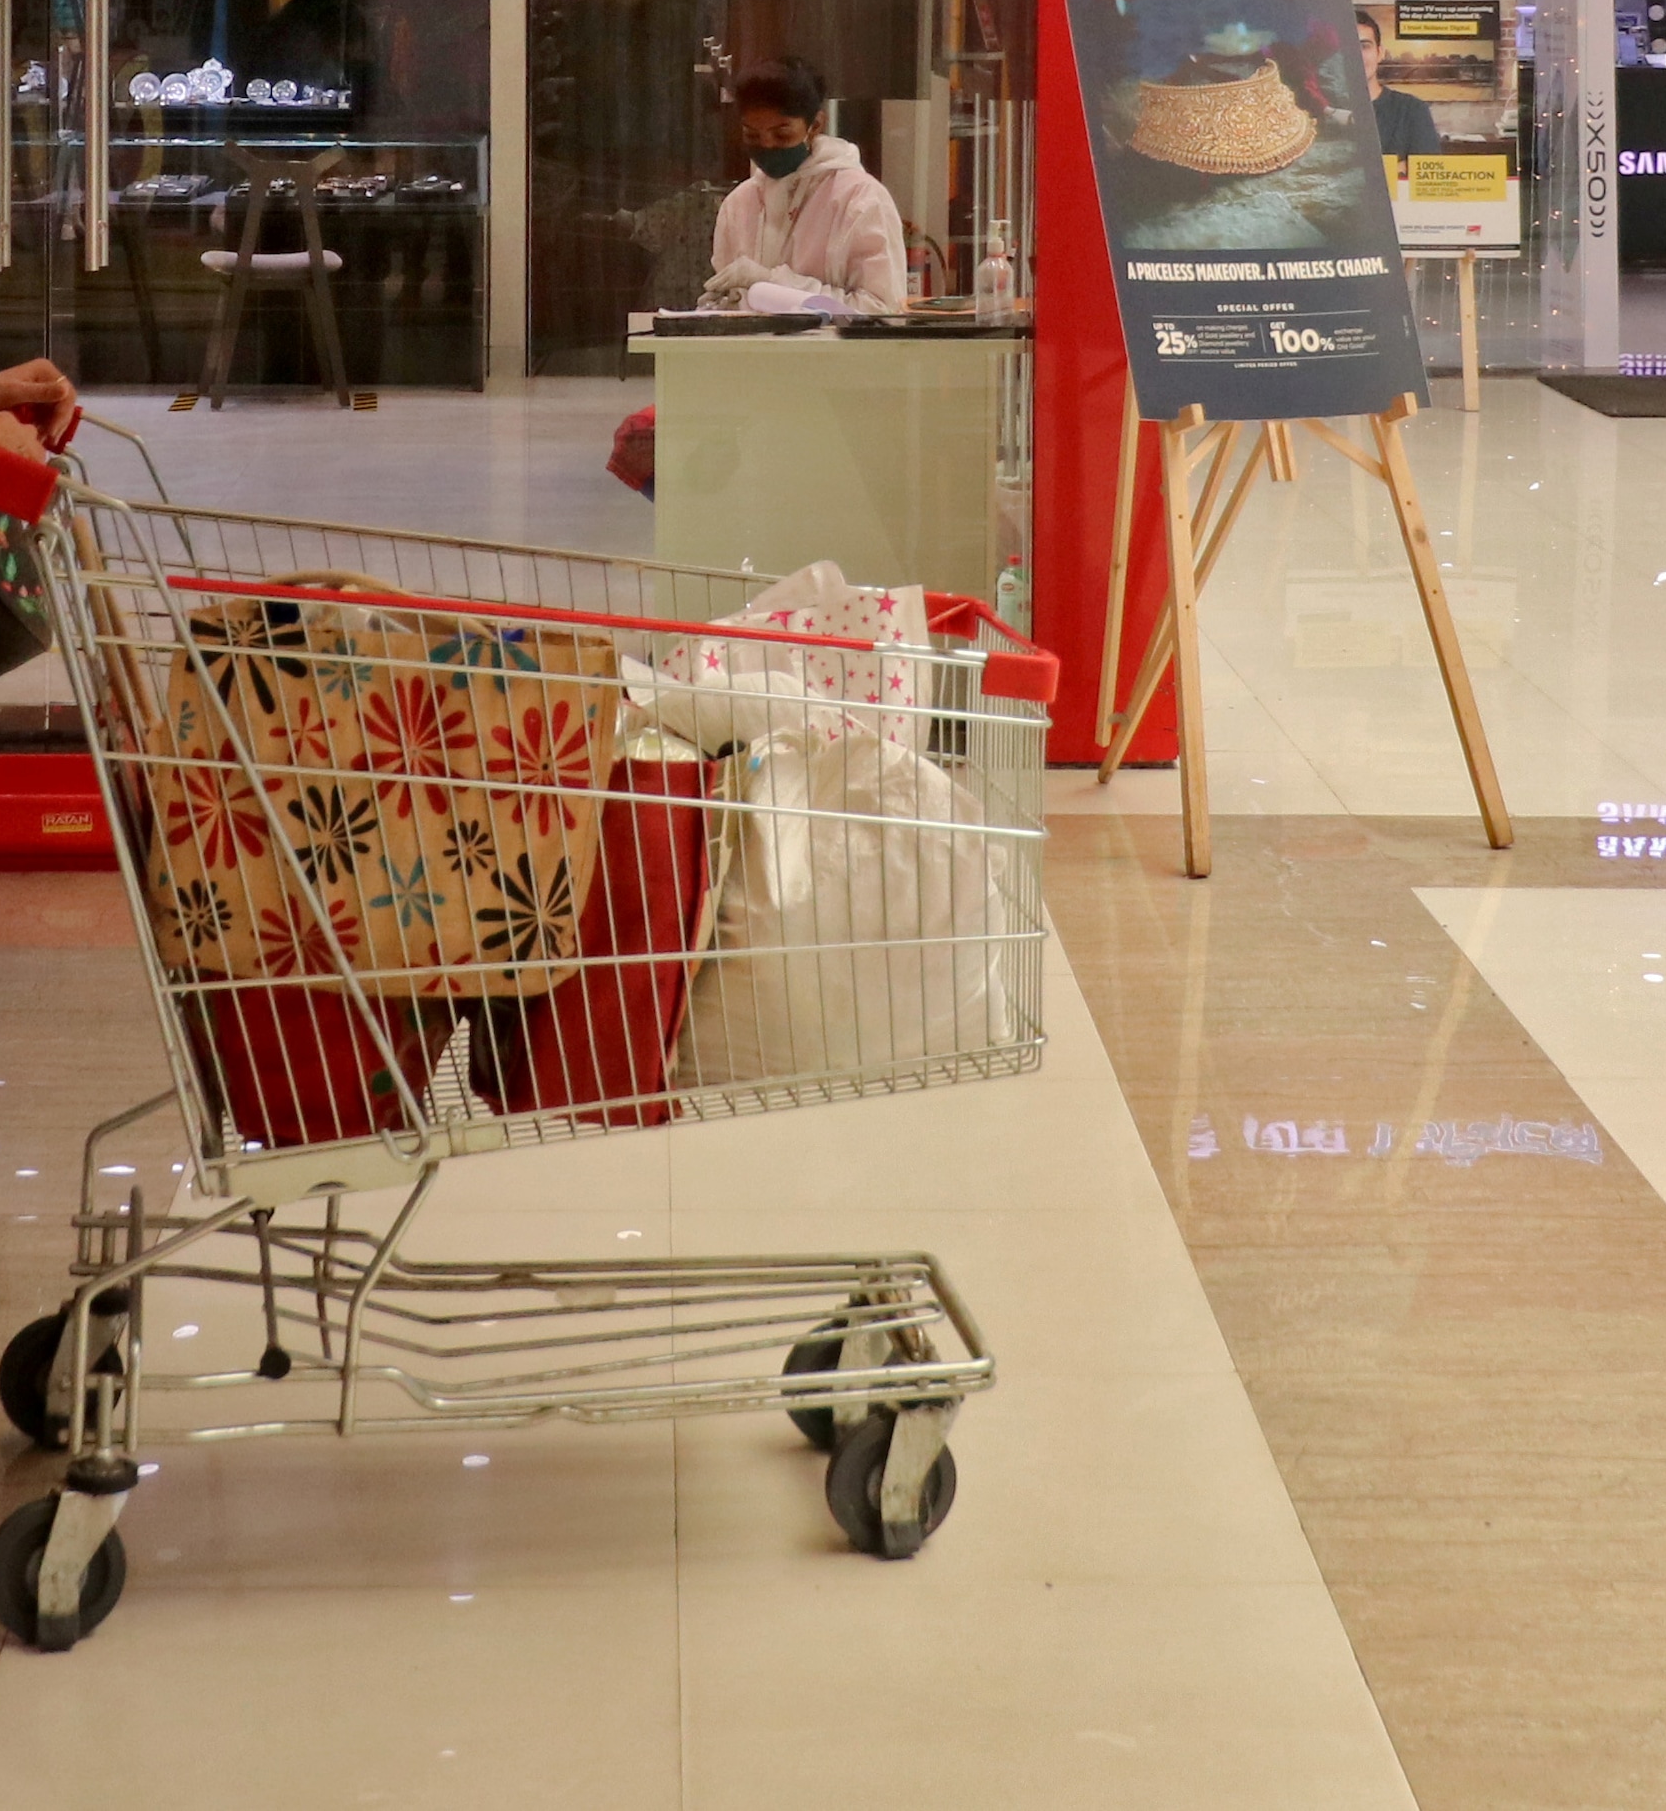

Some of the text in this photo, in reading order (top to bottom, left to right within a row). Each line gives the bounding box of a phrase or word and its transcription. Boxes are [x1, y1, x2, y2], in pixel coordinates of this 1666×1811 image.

[1416, 161, 1444, 171] 100%
[1415, 171, 1495, 180] SATISFACTION
[1127, 256, 1390, 281] A PRICELESS MAKEOVER. A TIMELESS CHARM.
[1217, 302, 1295, 313] SPECIAL OFFER
[1153, 322, 1175, 330] UP TO
[1269, 321, 1286, 330] GET
[1155, 330, 1199, 356] 25%
[1269, 328, 1335, 354] 100%
